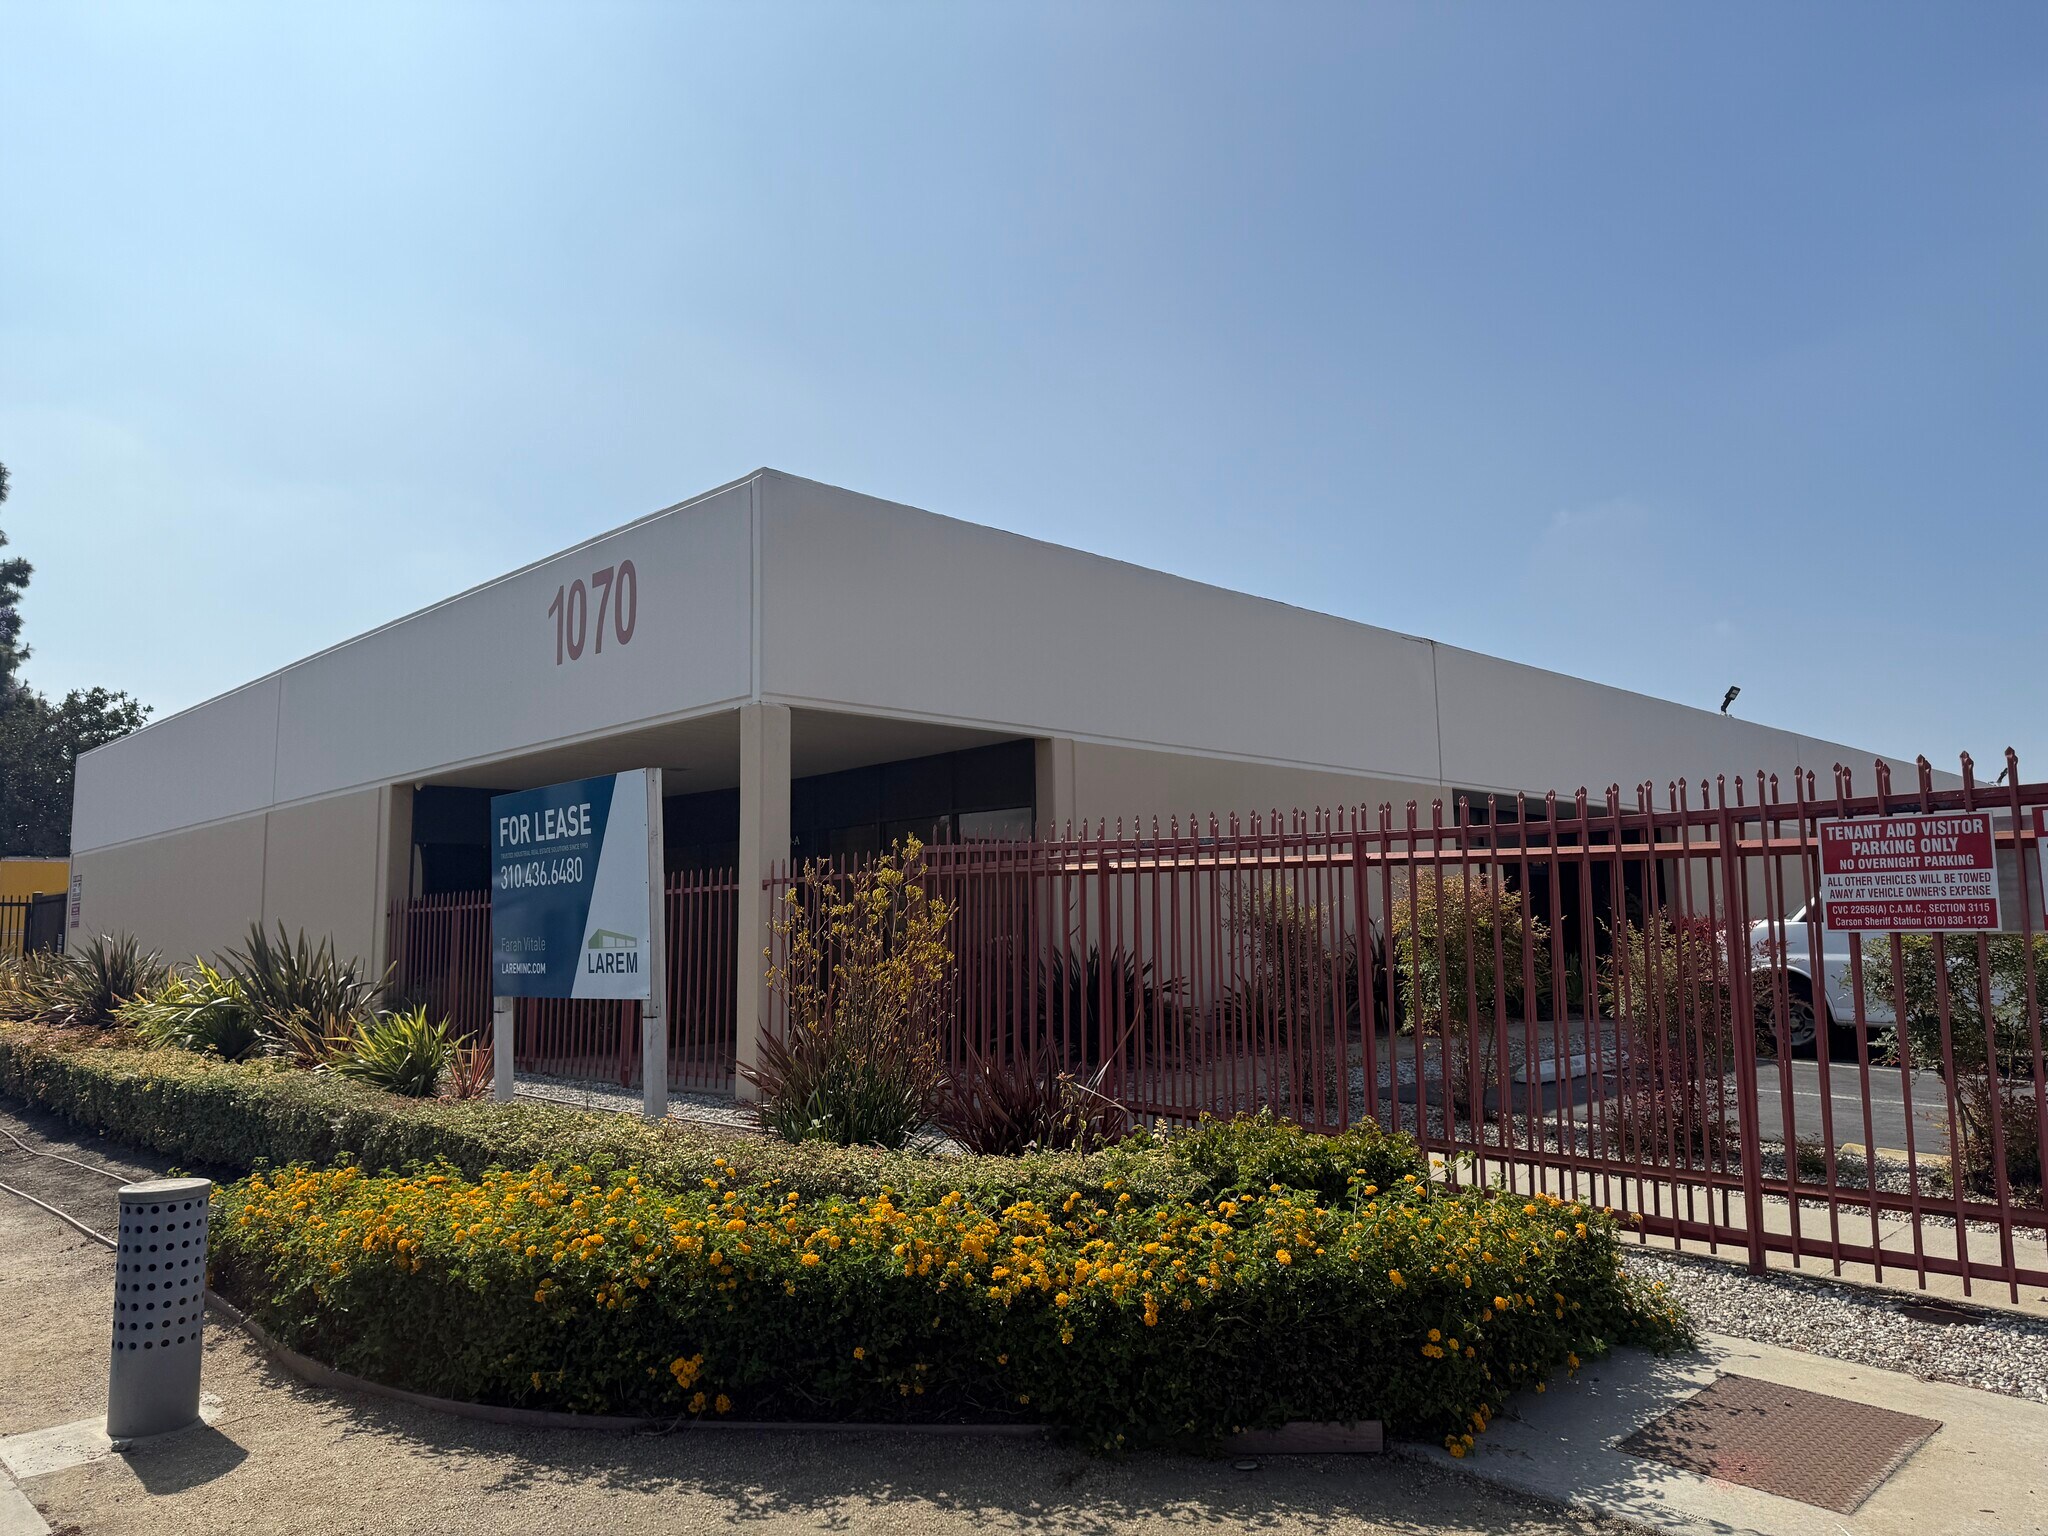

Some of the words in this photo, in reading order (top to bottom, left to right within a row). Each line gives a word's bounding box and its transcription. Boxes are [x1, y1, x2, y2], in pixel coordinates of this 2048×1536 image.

[547, 559, 637, 666] 1070
[500, 813, 531, 847] FOR
[534, 803, 592, 842] LEASE
[1826, 824, 1882, 840] TENANT
[1886, 822, 1916, 838] AND
[1921, 818, 1984, 836] VISITOR
[1852, 839, 1916, 856] PARKING
[1920, 837, 1958, 853] ONLY
[1840, 859, 1854, 870] NO
[1858, 856, 1920, 870] OVERNIGHT
[1924, 854, 1974, 867] PARKING
[500, 856, 583, 890] 310.436.6480
[1828, 877, 1843, 887] ALL
[1845, 876, 1872, 886] OTHER
[1875, 874, 1916, 885] VEHICLES
[1919, 874, 1942, 884] WILL
[1944, 873, 1956, 884] BE
[1958, 872, 1990, 882] TOWED
[1830, 888, 1853, 899] AWAY
[1856, 888, 1866, 898] AT
[1868, 888, 1904, 898] VEHICLE
[1906, 886, 1946, 897] OWNER'S
[1950, 885, 1990, 896] EXPENSE
[1832, 905, 1848, 914] CVC
[1850, 904, 1886, 915] 22658(A)
[1928, 903, 1966, 912] SECTION
[1968, 902, 1990, 912] 3115
[1836, 918, 1862, 926] Carson
[1864, 916, 1890, 926] Sheriff
[1894, 916, 1922, 926] Station
[1924, 916, 1946, 926] (310)
[1948, 915, 1988, 925] 830-1123
[523, 936, 546, 951] Vitale
[502, 962, 546, 974] LAREMINC.COM
[588, 952, 638, 974] LAREM
